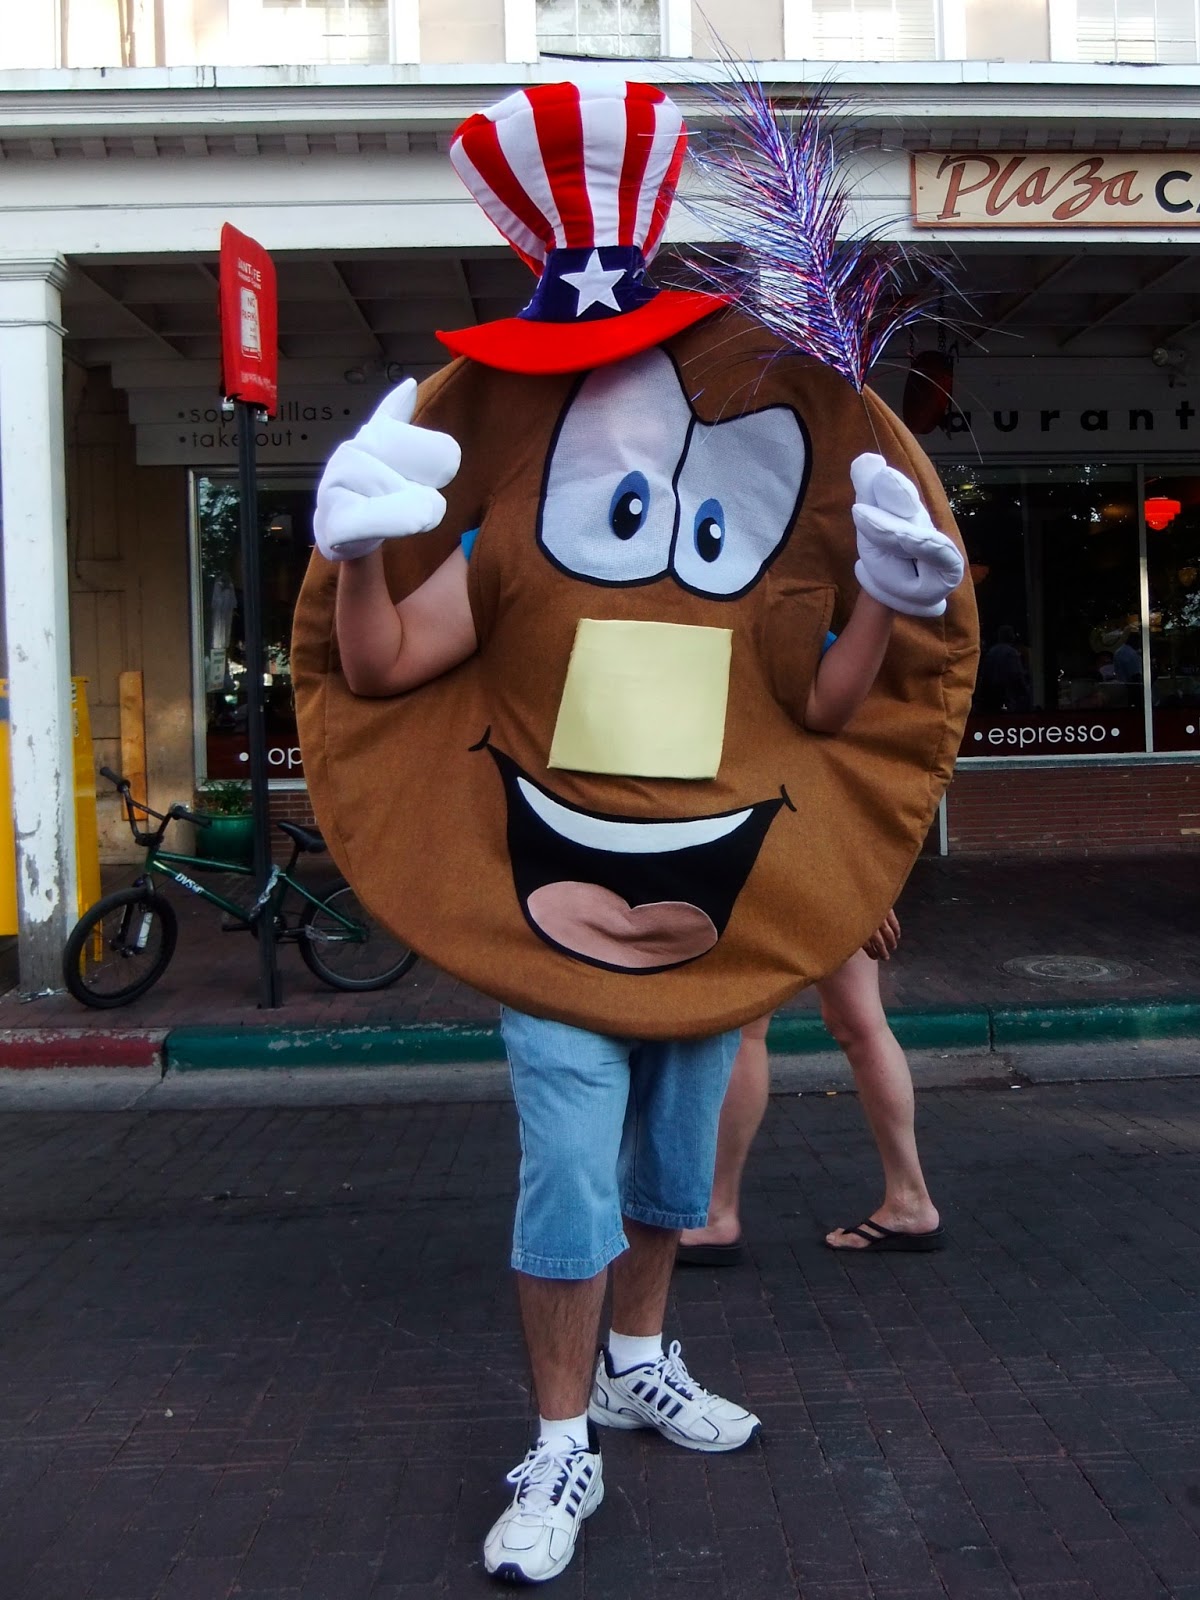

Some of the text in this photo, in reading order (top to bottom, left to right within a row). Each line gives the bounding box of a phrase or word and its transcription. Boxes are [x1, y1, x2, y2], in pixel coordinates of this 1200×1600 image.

[936, 154, 1200, 220] Plaza C
[190, 402, 333, 427] sopillas
[192, 428, 293, 448] take out
[988, 725, 1106, 748] espresso
